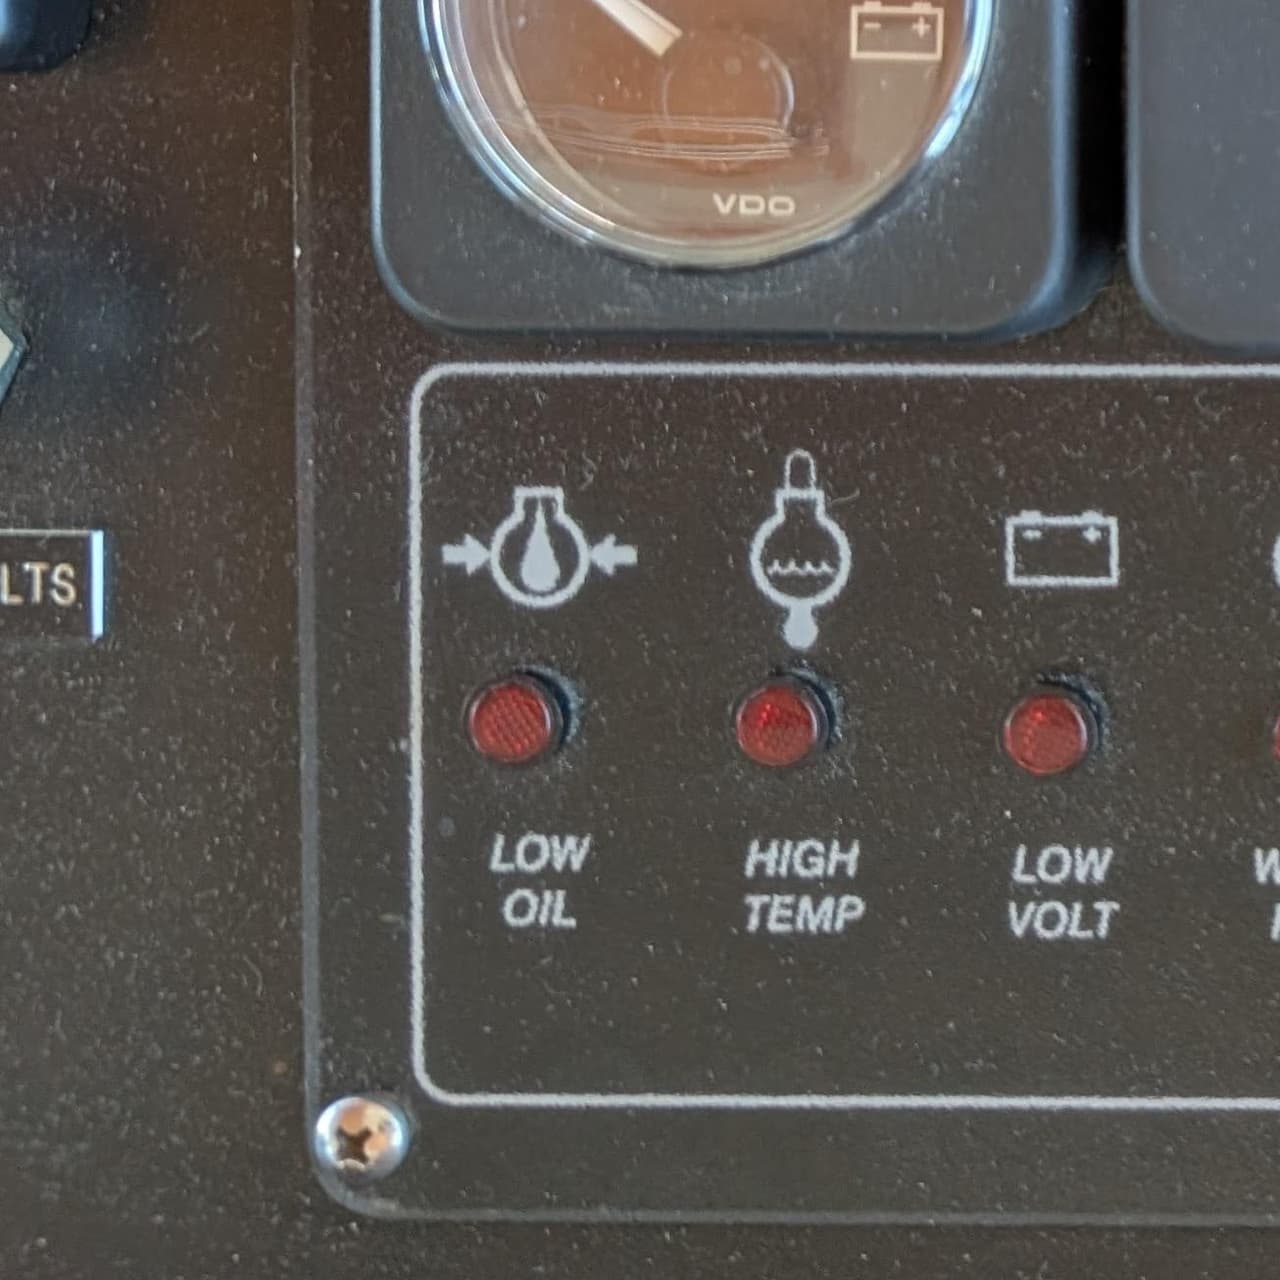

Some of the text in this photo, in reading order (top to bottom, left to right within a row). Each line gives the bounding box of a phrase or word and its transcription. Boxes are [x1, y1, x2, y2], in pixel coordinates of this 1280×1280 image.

[713, 193, 796, 216] VDO
[488, 833, 591, 873] LOW
[744, 839, 860, 879] HIGH
[1012, 845, 1113, 884] LOW
[503, 889, 577, 929] OIL
[744, 894, 865, 934] TEMP
[1009, 900, 1120, 940] VOLT
